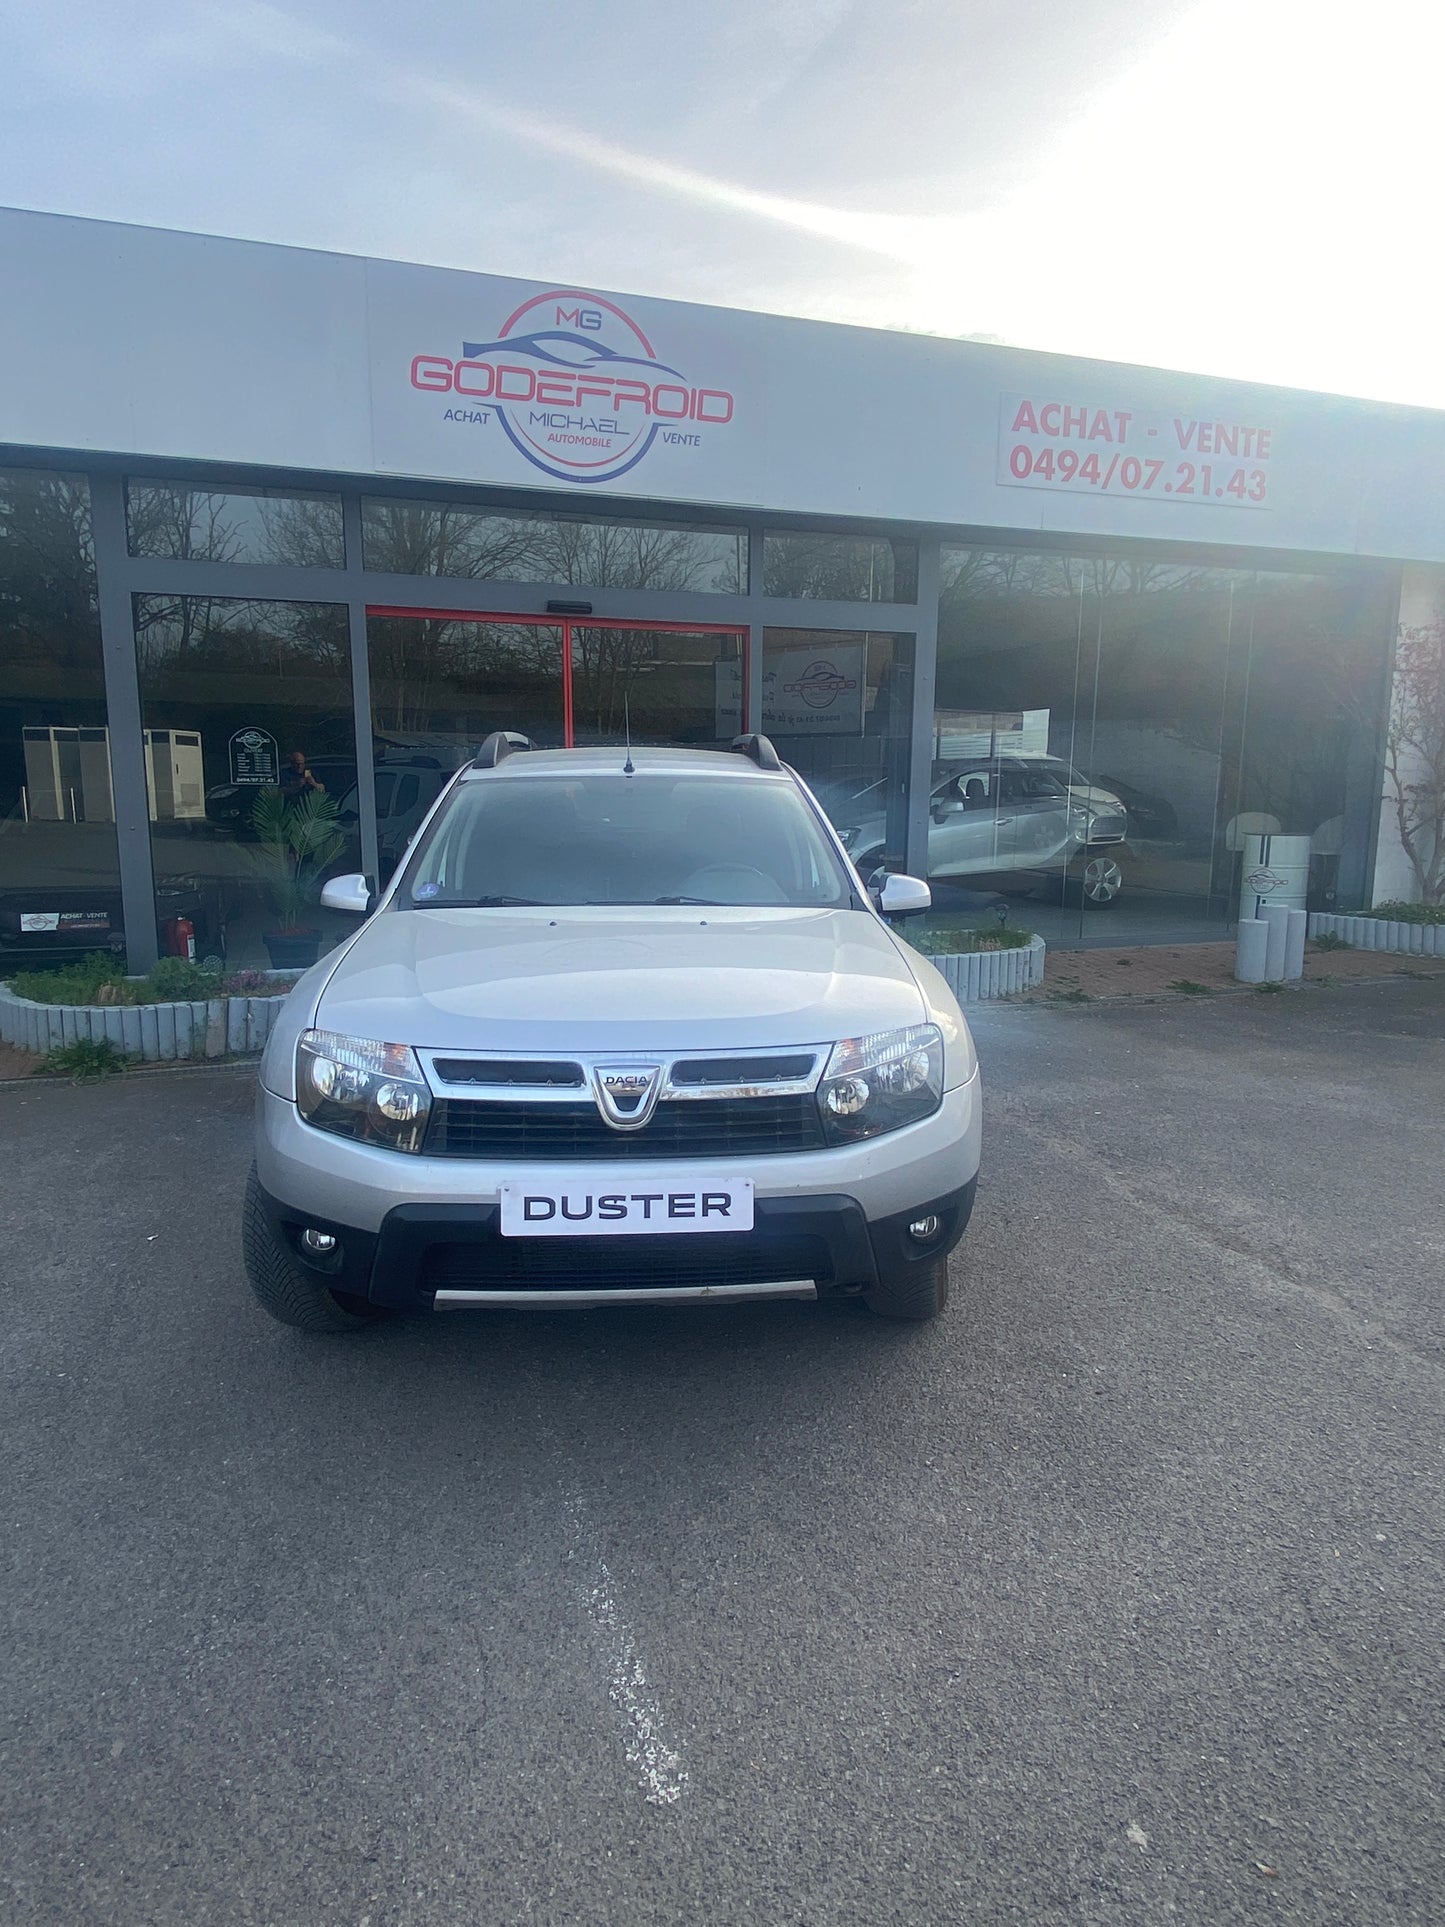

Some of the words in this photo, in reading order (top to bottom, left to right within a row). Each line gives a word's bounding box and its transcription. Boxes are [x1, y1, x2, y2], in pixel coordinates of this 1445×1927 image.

[557, 306, 602, 330] MG
[411, 355, 733, 424] GODEFROID
[443, 409, 490, 425] ACHAT
[529, 411, 629, 435] MICHAEL
[547, 434, 611, 448] AUTOMOBILE
[662, 432, 700, 447] VENTE
[1011, 400, 1132, 443] ACHAT
[1174, 418, 1272, 459] VENTE
[1010, 445, 1266, 501] 0494/07.21.43
[606, 1076, 648, 1085] DACIA
[524, 1192, 731, 1221] DUSTER
